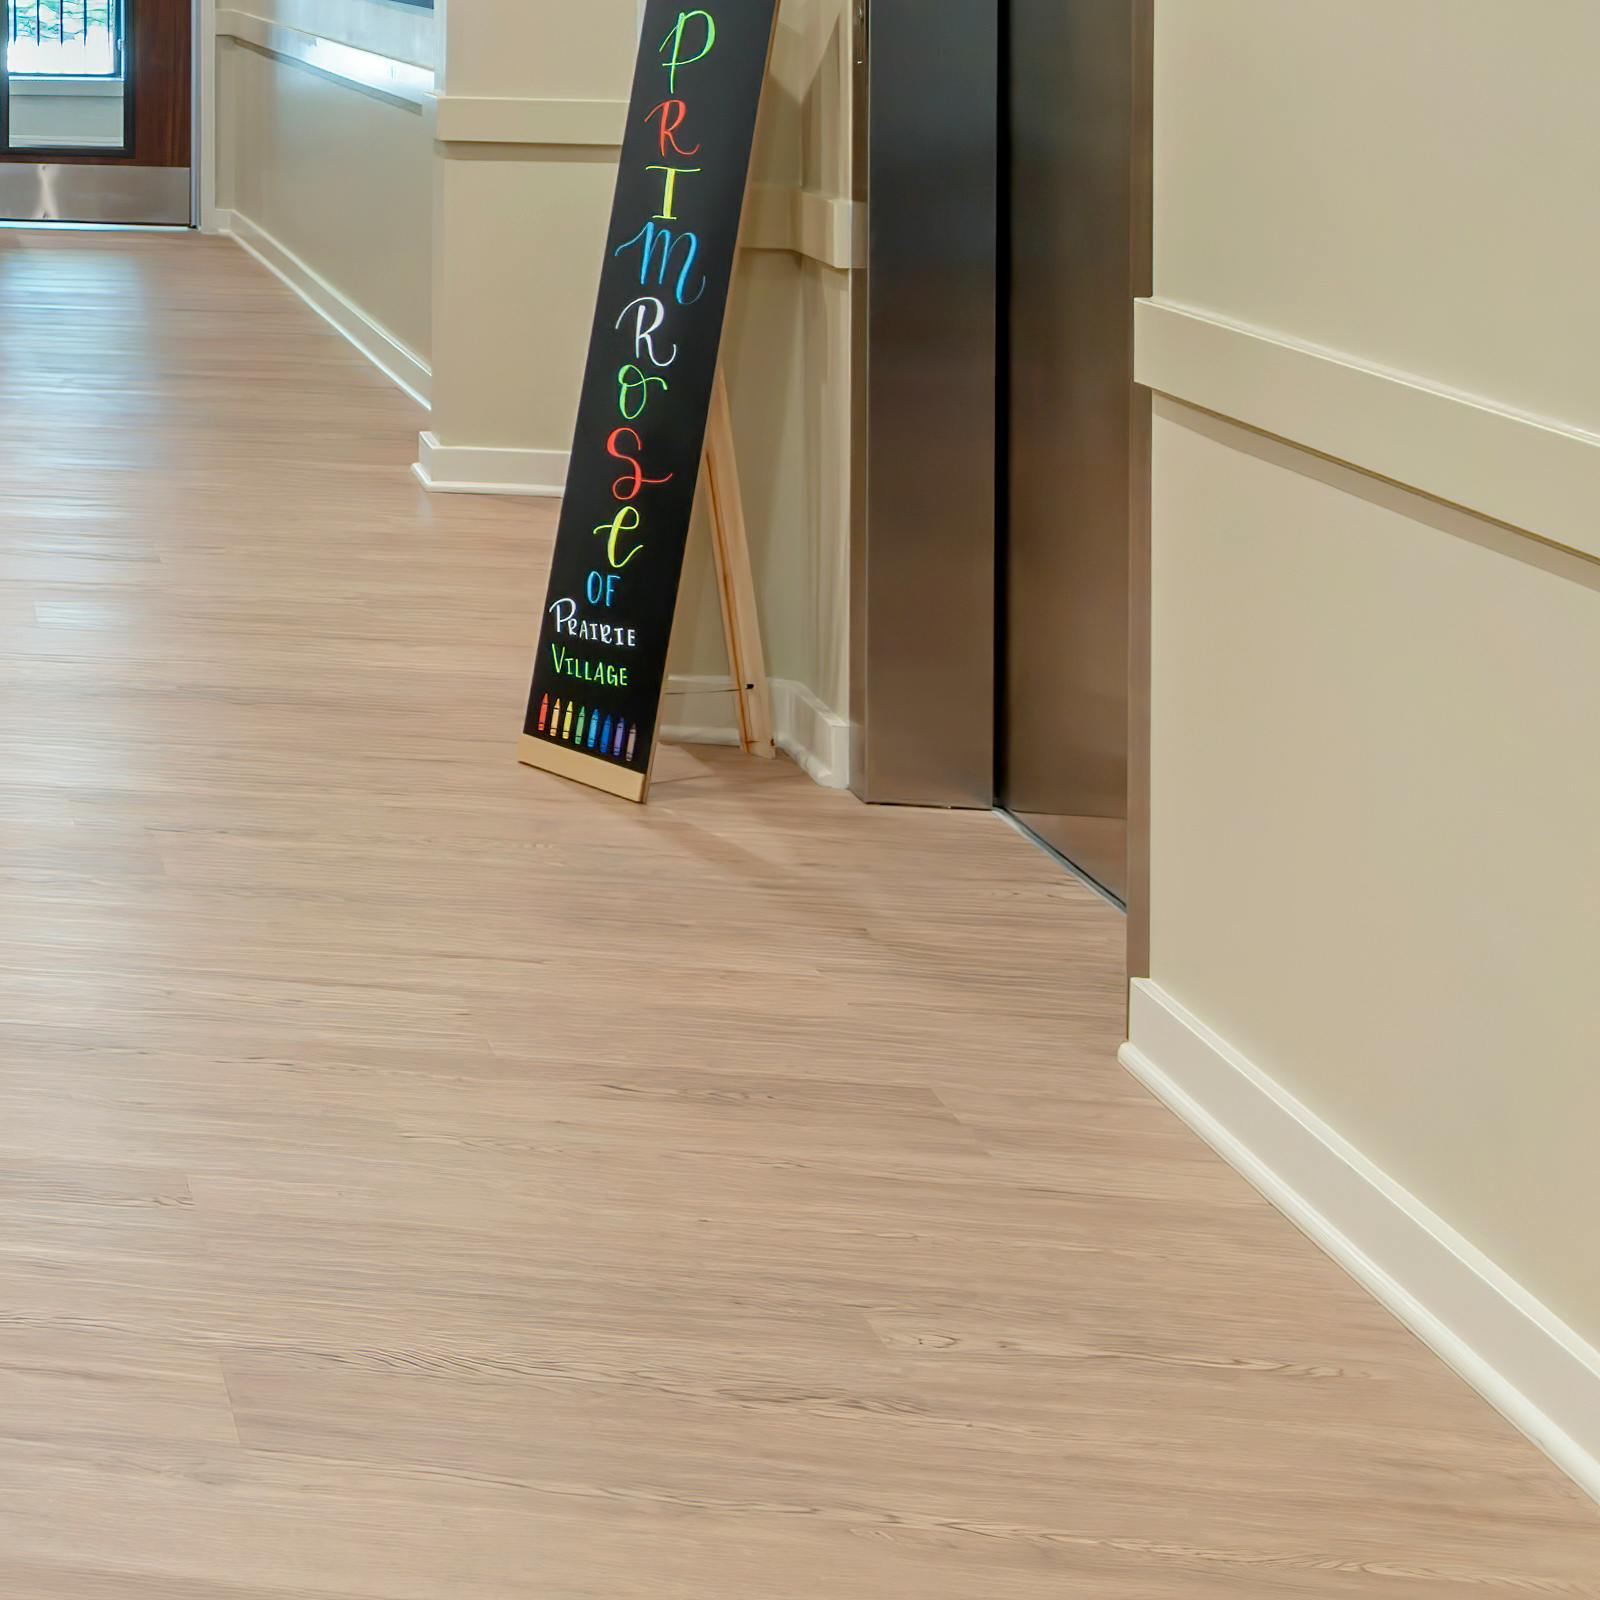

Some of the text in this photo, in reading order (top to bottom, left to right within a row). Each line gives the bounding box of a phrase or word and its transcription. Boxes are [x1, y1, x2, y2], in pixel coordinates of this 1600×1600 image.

[586, 570, 621, 607] OF
[548, 597, 637, 647] PRAIRIE
[551, 642, 629, 687] VILLAGE
